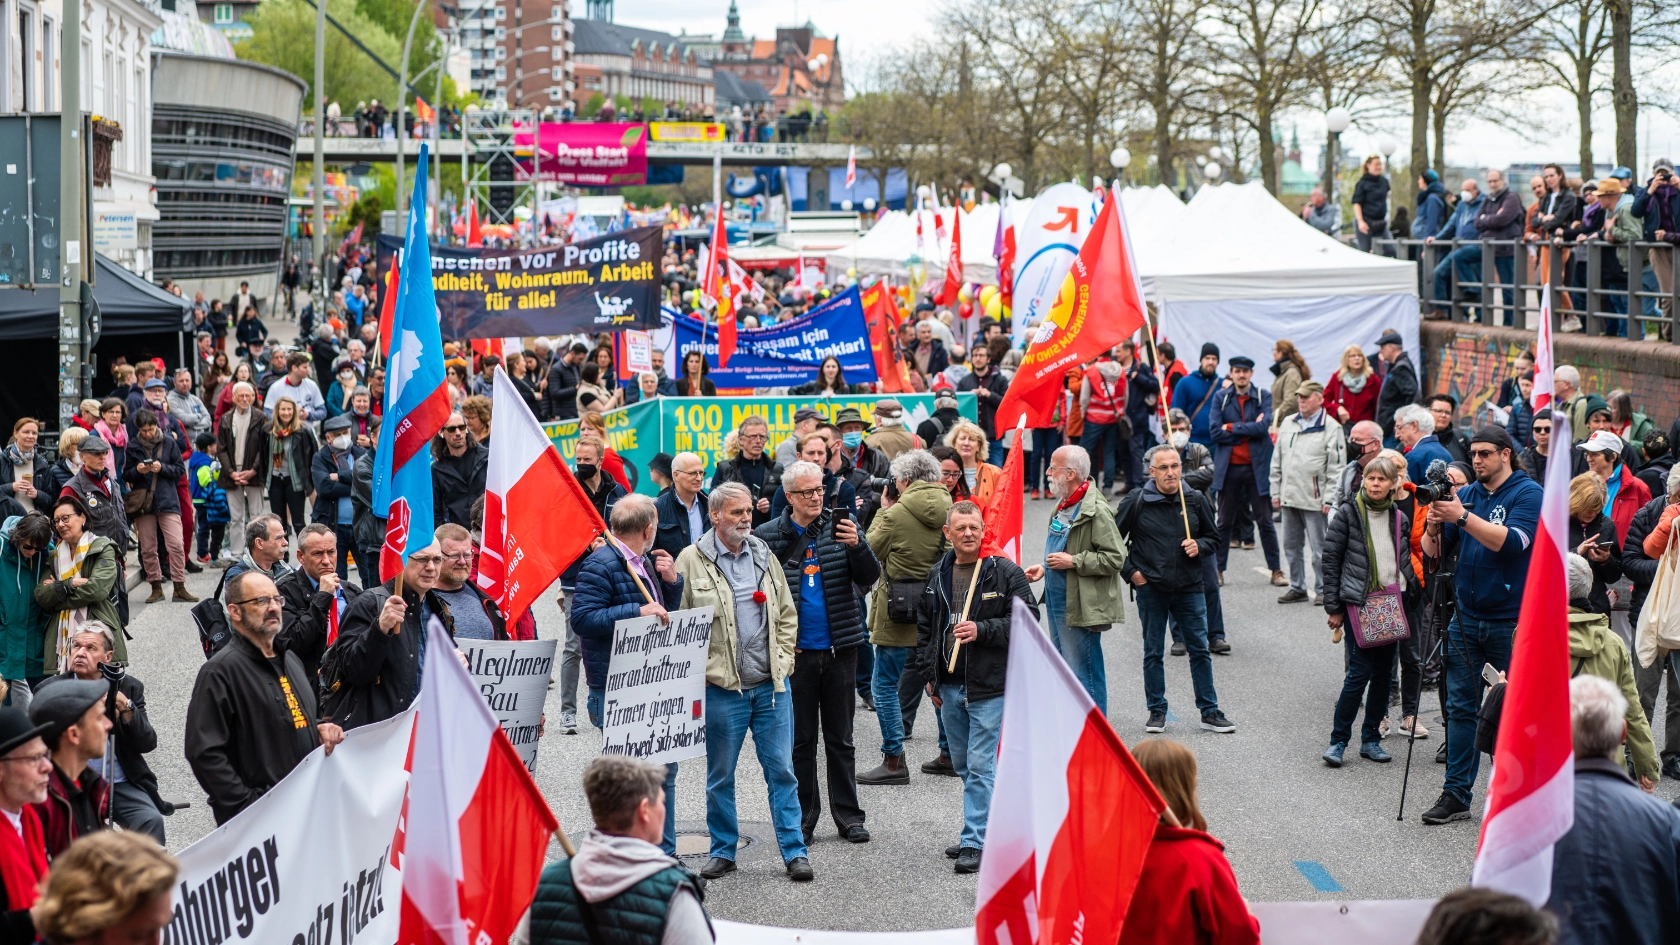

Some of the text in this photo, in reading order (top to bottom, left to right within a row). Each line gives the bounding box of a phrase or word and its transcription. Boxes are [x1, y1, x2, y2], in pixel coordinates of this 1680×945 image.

[558, 143, 593, 158] Press
[595, 145, 628, 158] Start
[99, 214, 134, 223] Petersen
[399, 239, 641, 271] nschen vor Profite
[495, 269, 594, 291] Wohnraum,
[600, 261, 654, 282] Arbeit
[485, 290, 556, 311] für alle!
[802, 328, 829, 347] için
[814, 336, 866, 361] haklar!
[674, 404, 723, 432] 100
[675, 432, 723, 450] IN DIE
[614, 627, 641, 656] Wenn
[674, 613, 713, 649] Aufträge
[464, 647, 551, 685] llegInnen
[607, 671, 628, 692] nur
[627, 668, 641, 688] an
[480, 683, 519, 712] Bau
[605, 691, 687, 729] Firmen gingen.
[158, 833, 281, 945] mburger
